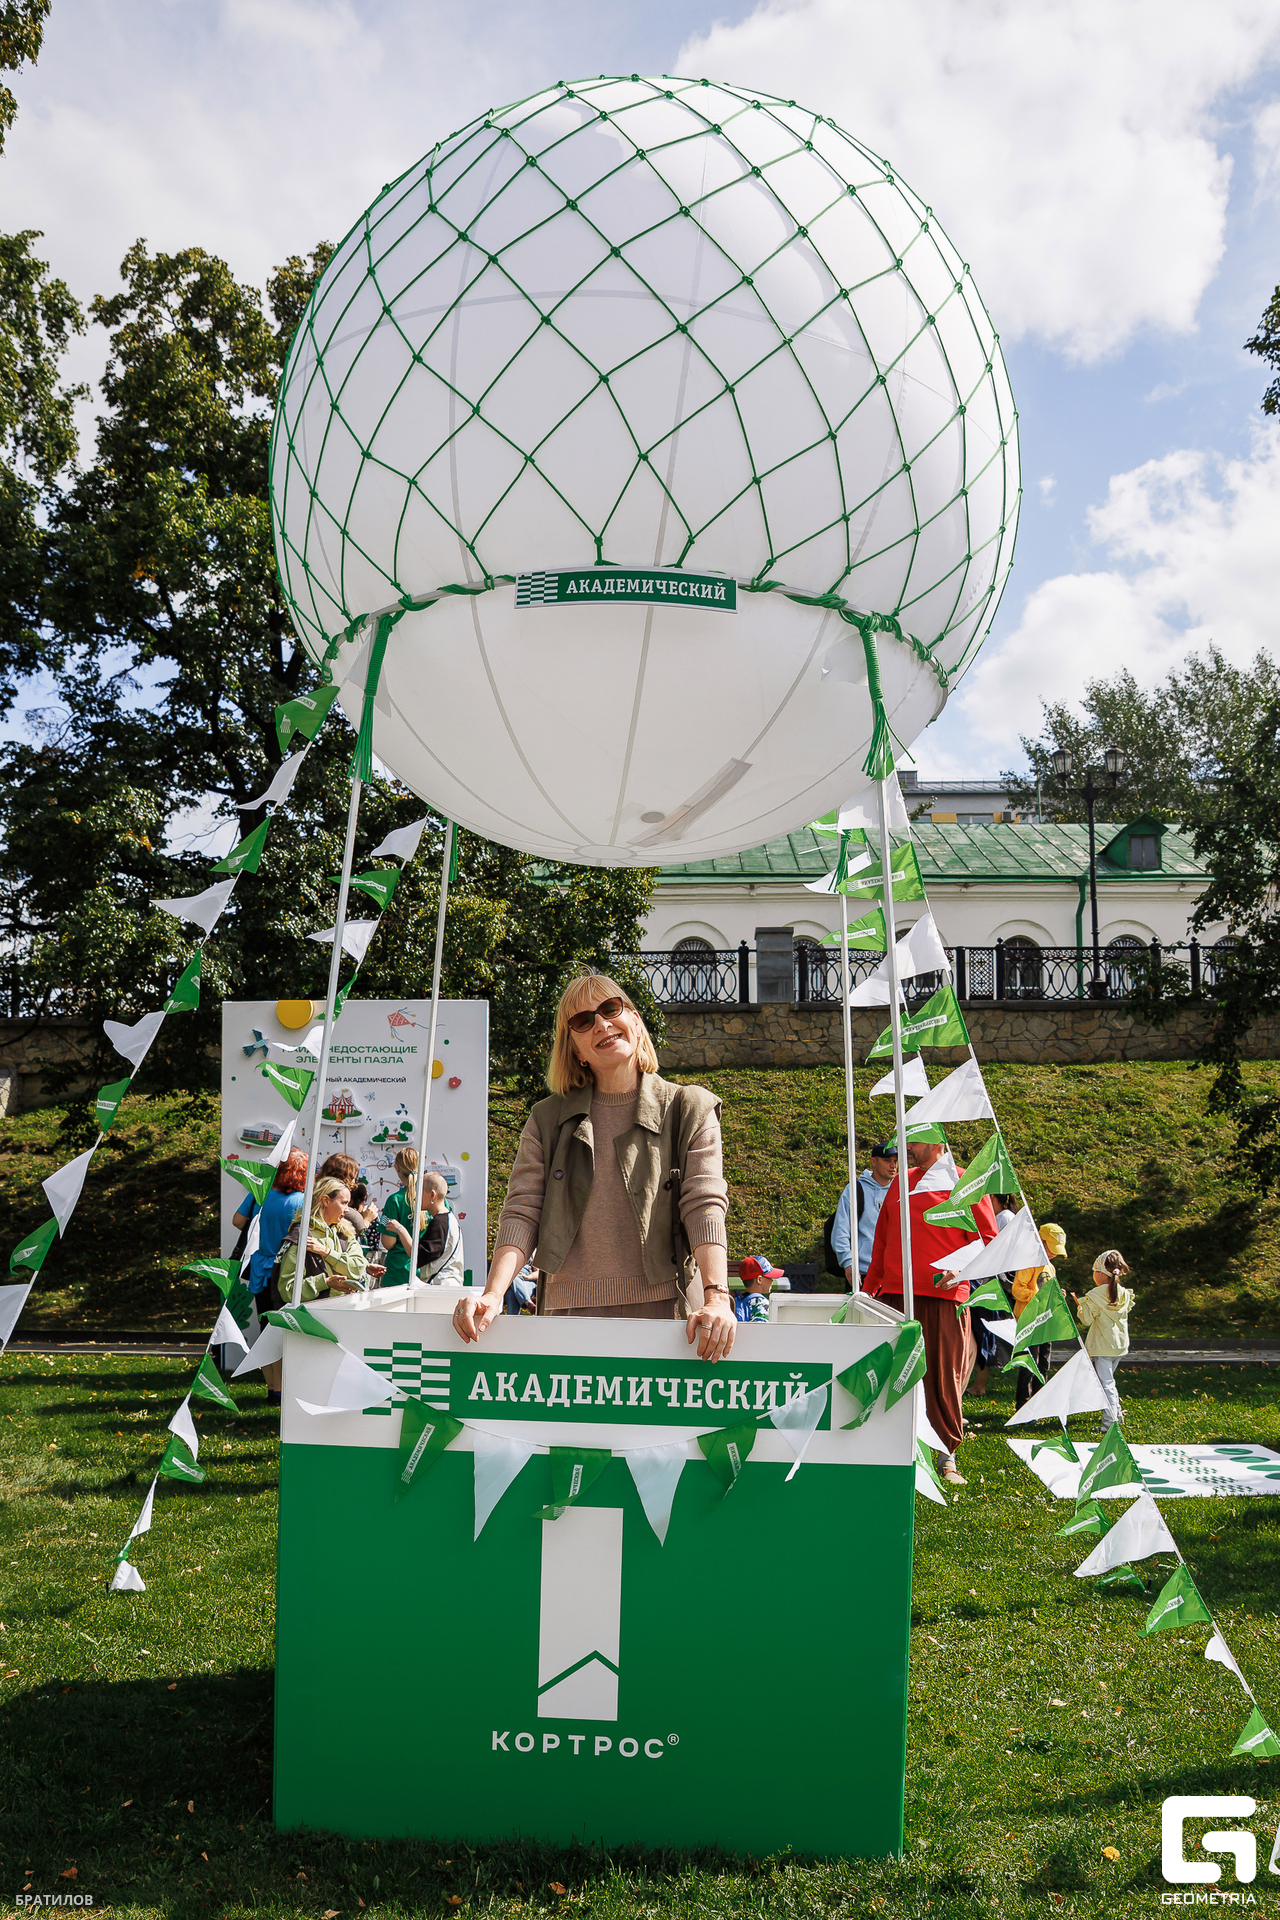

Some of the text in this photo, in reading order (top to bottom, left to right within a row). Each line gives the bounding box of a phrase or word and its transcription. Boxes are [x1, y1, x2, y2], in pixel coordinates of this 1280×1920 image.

[566, 578, 726, 600] АКАДЕМИЧЕСКИЙ
[468, 1371, 809, 1410] АКАДЕМИЧЕСКИЙ
[408, 1425, 433, 1470] АКАДЕМИЧЕСКИЙ
